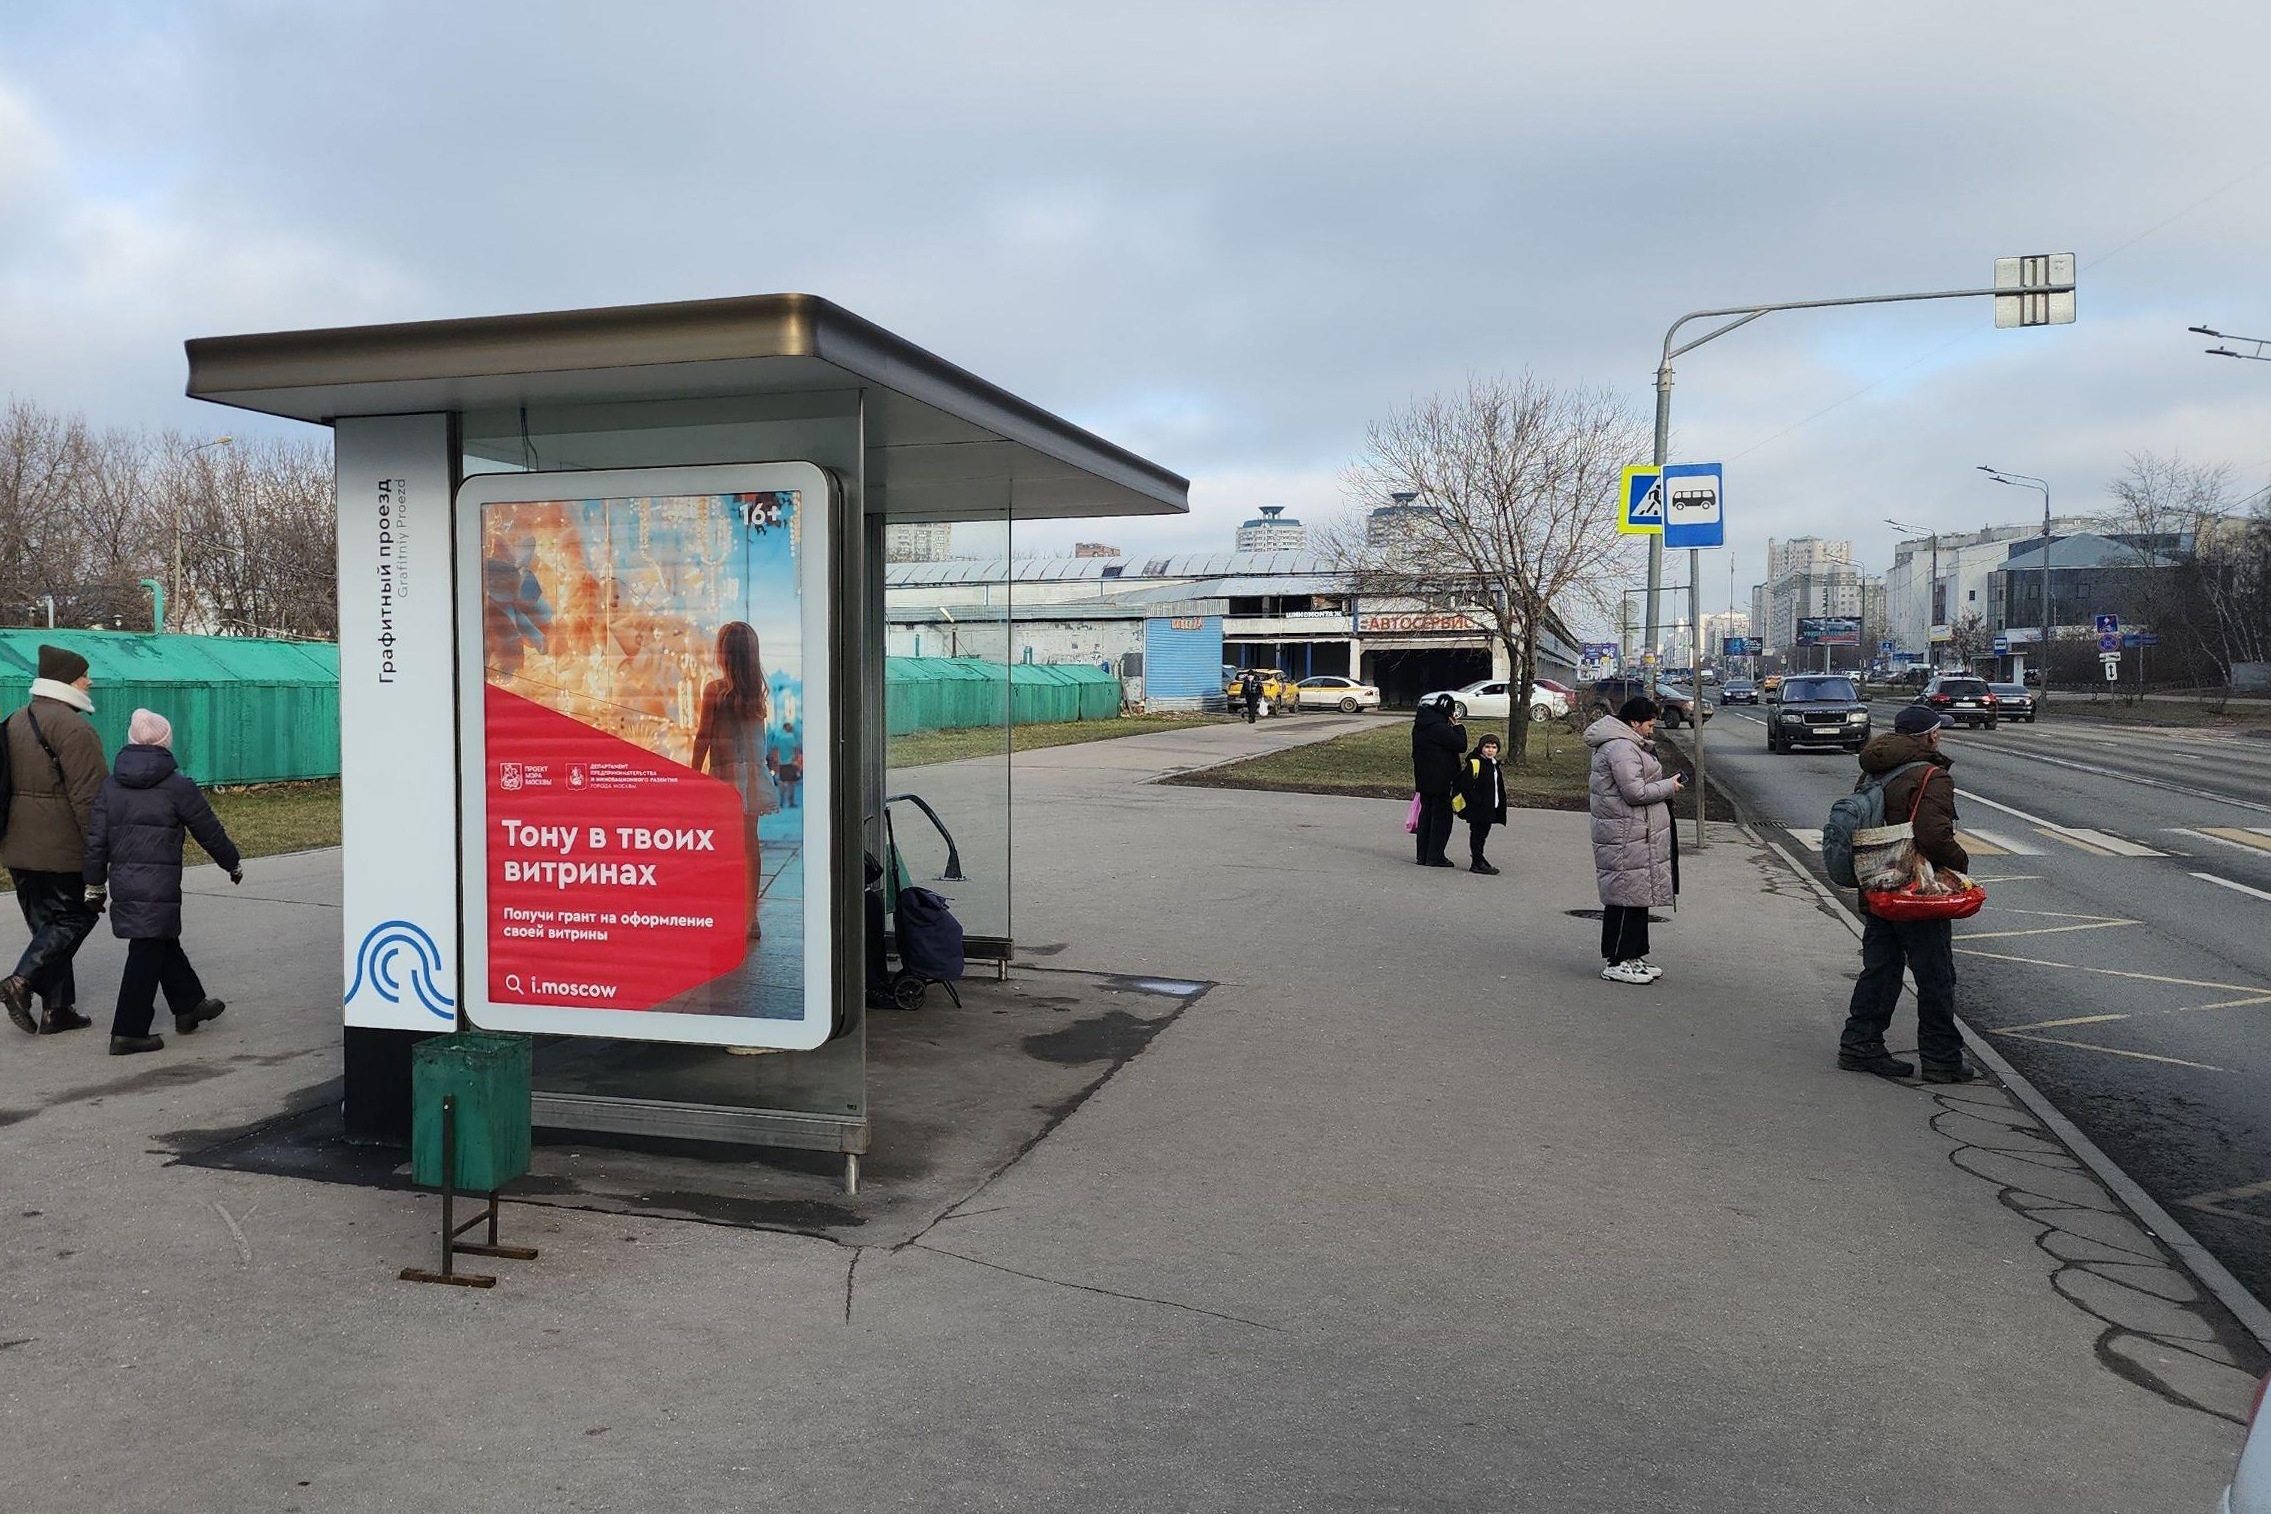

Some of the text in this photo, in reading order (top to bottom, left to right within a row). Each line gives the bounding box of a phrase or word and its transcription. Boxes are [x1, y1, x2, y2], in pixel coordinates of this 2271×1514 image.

[739, 502, 781, 525] 16+
[395, 478, 409, 598] Grafitniy Proezd
[376, 478, 397, 683] Графитный проезд
[524, 765, 548, 773] ПРОЕКТ
[501, 819, 715, 855] Тону в твоих
[504, 861, 657, 889] витринах
[503, 907, 714, 928] Получи грант на оформление
[503, 924, 608, 942] своей витрины
[530, 976, 617, 998] i.moscow
